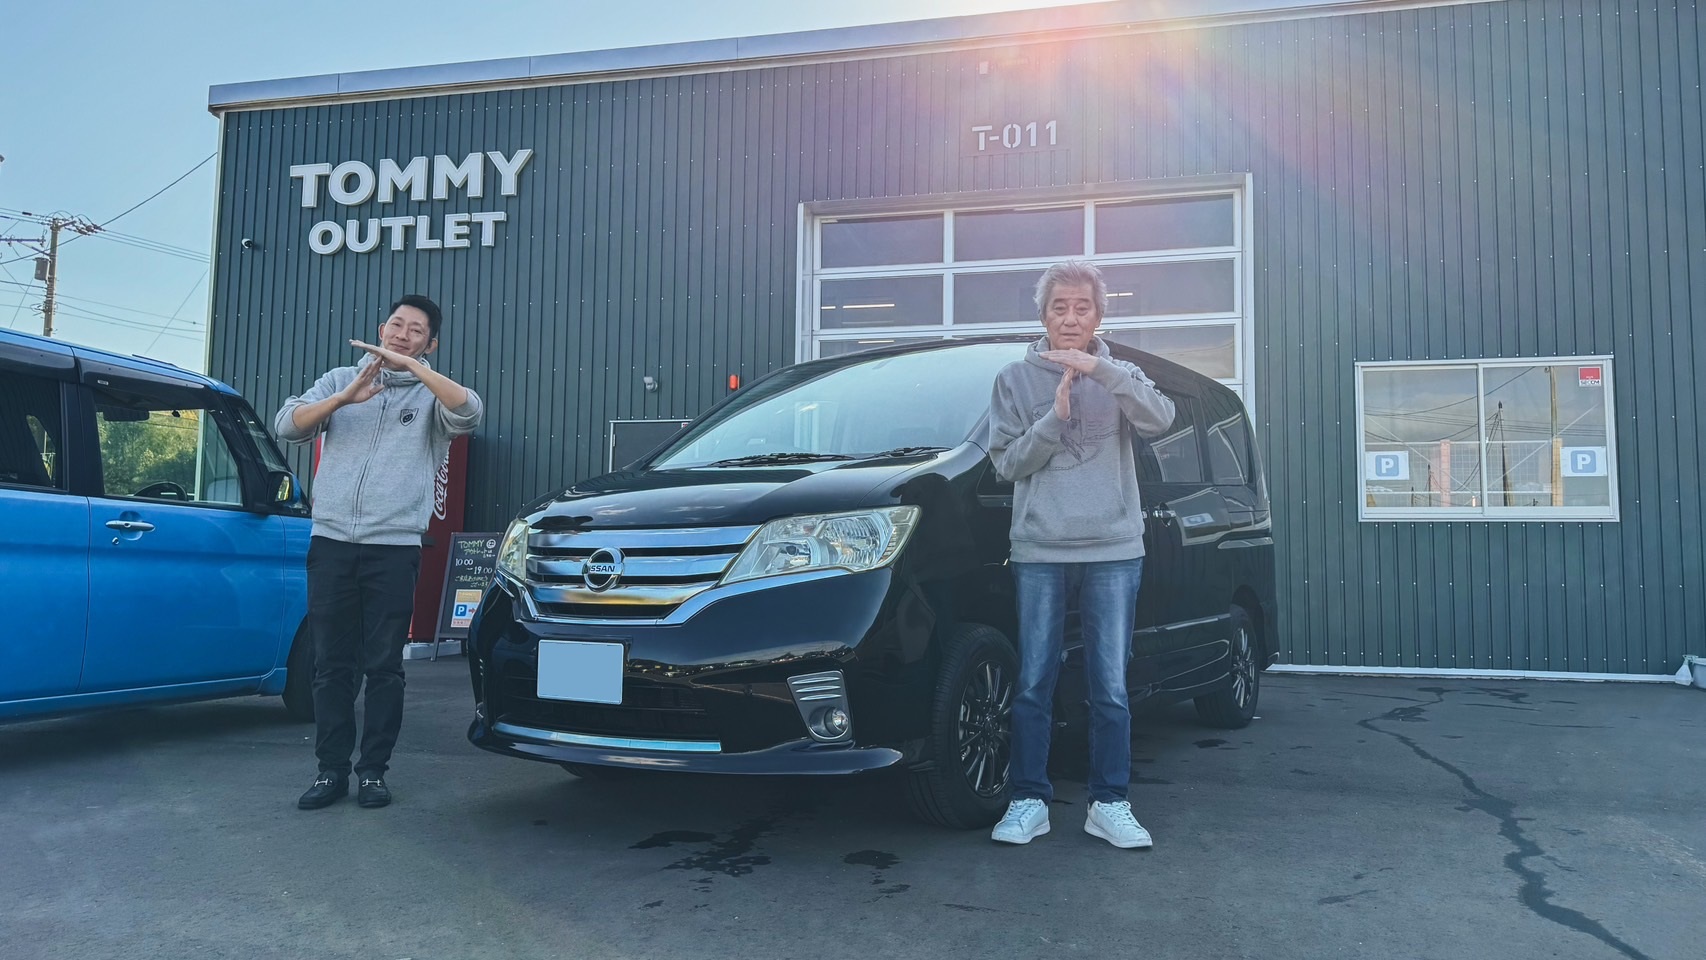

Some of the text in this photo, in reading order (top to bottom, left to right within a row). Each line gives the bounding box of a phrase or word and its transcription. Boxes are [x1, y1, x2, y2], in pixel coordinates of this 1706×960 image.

[972, 120, 1057, 150] T-011
[290, 149, 533, 208] TOMMY
[308, 211, 507, 255] OUTLET
[1381, 458, 1395, 474] P
[1577, 453, 1592, 470] P
[433, 440, 453, 520] Coca-Co
[458, 540, 485, 549] TOMMY
[457, 606, 465, 615] P
